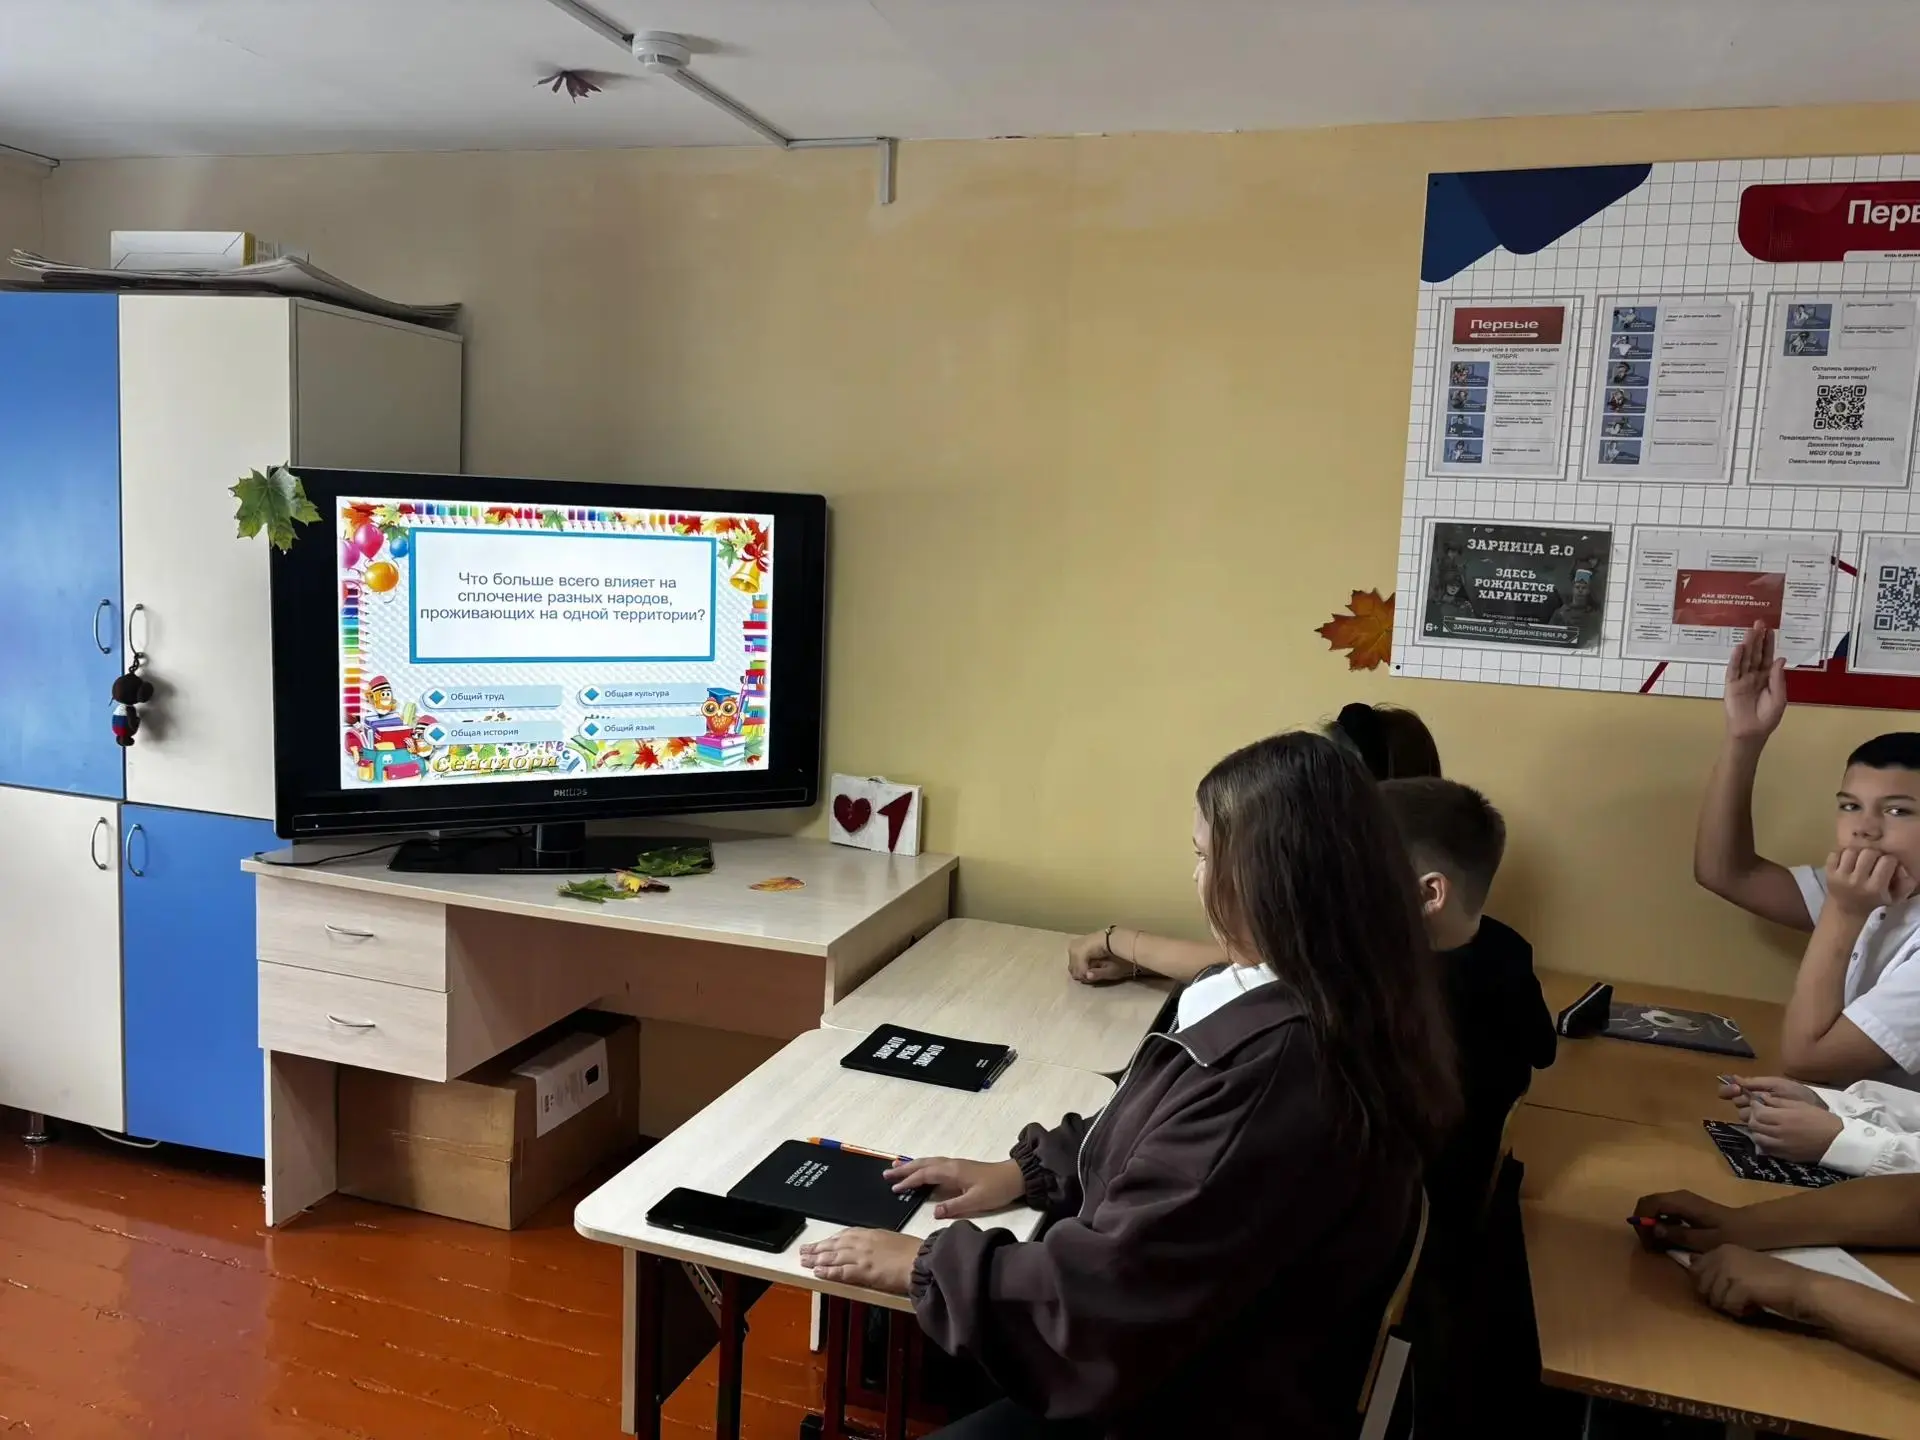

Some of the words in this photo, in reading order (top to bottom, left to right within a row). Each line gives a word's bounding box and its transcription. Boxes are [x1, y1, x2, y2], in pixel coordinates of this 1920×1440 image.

[1470, 319, 1540, 332] Первые
[1466, 538, 1545, 556] ЗАРНИЦА
[1550, 544, 1575, 557] 2.0
[458, 571, 488, 585] Что
[493, 572, 554, 586] больше
[558, 576, 600, 587] всего
[604, 577, 656, 588] влияет
[659, 578, 677, 588] на
[1495, 567, 1537, 579] ЗДЕСЬ
[1474, 577, 1555, 593] РОЖДАЕТСЯ
[457, 591, 543, 603] сплочение
[547, 592, 603, 606] разных
[607, 593, 673, 607] народов,
[1478, 589, 1549, 603] ХАРАКТЕР
[420, 607, 535, 622] проживающих
[540, 608, 558, 619] на
[562, 608, 609, 622] одной
[613, 608, 706, 623] территории?
[1425, 622, 1439, 632] 6+
[450, 692, 482, 702] Общий
[484, 693, 505, 702] труд
[604, 690, 632, 699] Общая
[634, 690, 670, 699] культура
[451, 729, 481, 738] Общая
[483, 729, 519, 737] история
[604, 724, 634, 733] Общий
